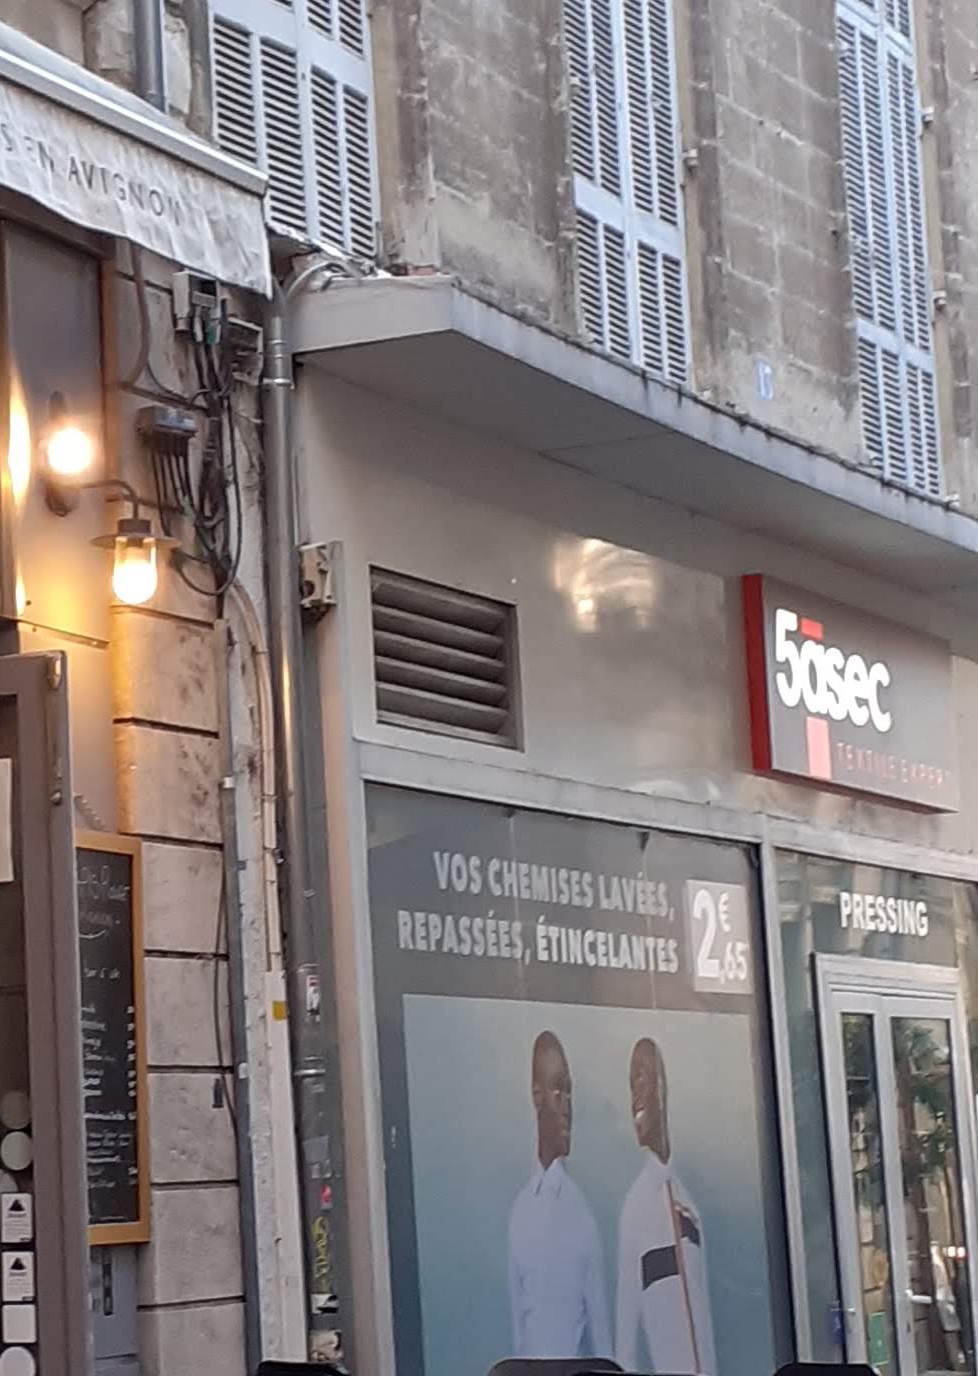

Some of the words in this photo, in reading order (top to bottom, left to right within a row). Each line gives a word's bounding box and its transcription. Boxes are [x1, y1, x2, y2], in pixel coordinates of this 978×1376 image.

[433, 851, 482, 895] VOS
[487, 857, 595, 909] CHEMISES
[598, 871, 675, 921] LAVÉES,
[839, 891, 930, 937] PRESSING
[396, 909, 531, 966] REPASSÉES,
[535, 915, 679, 974] ÉTINCELANTES
